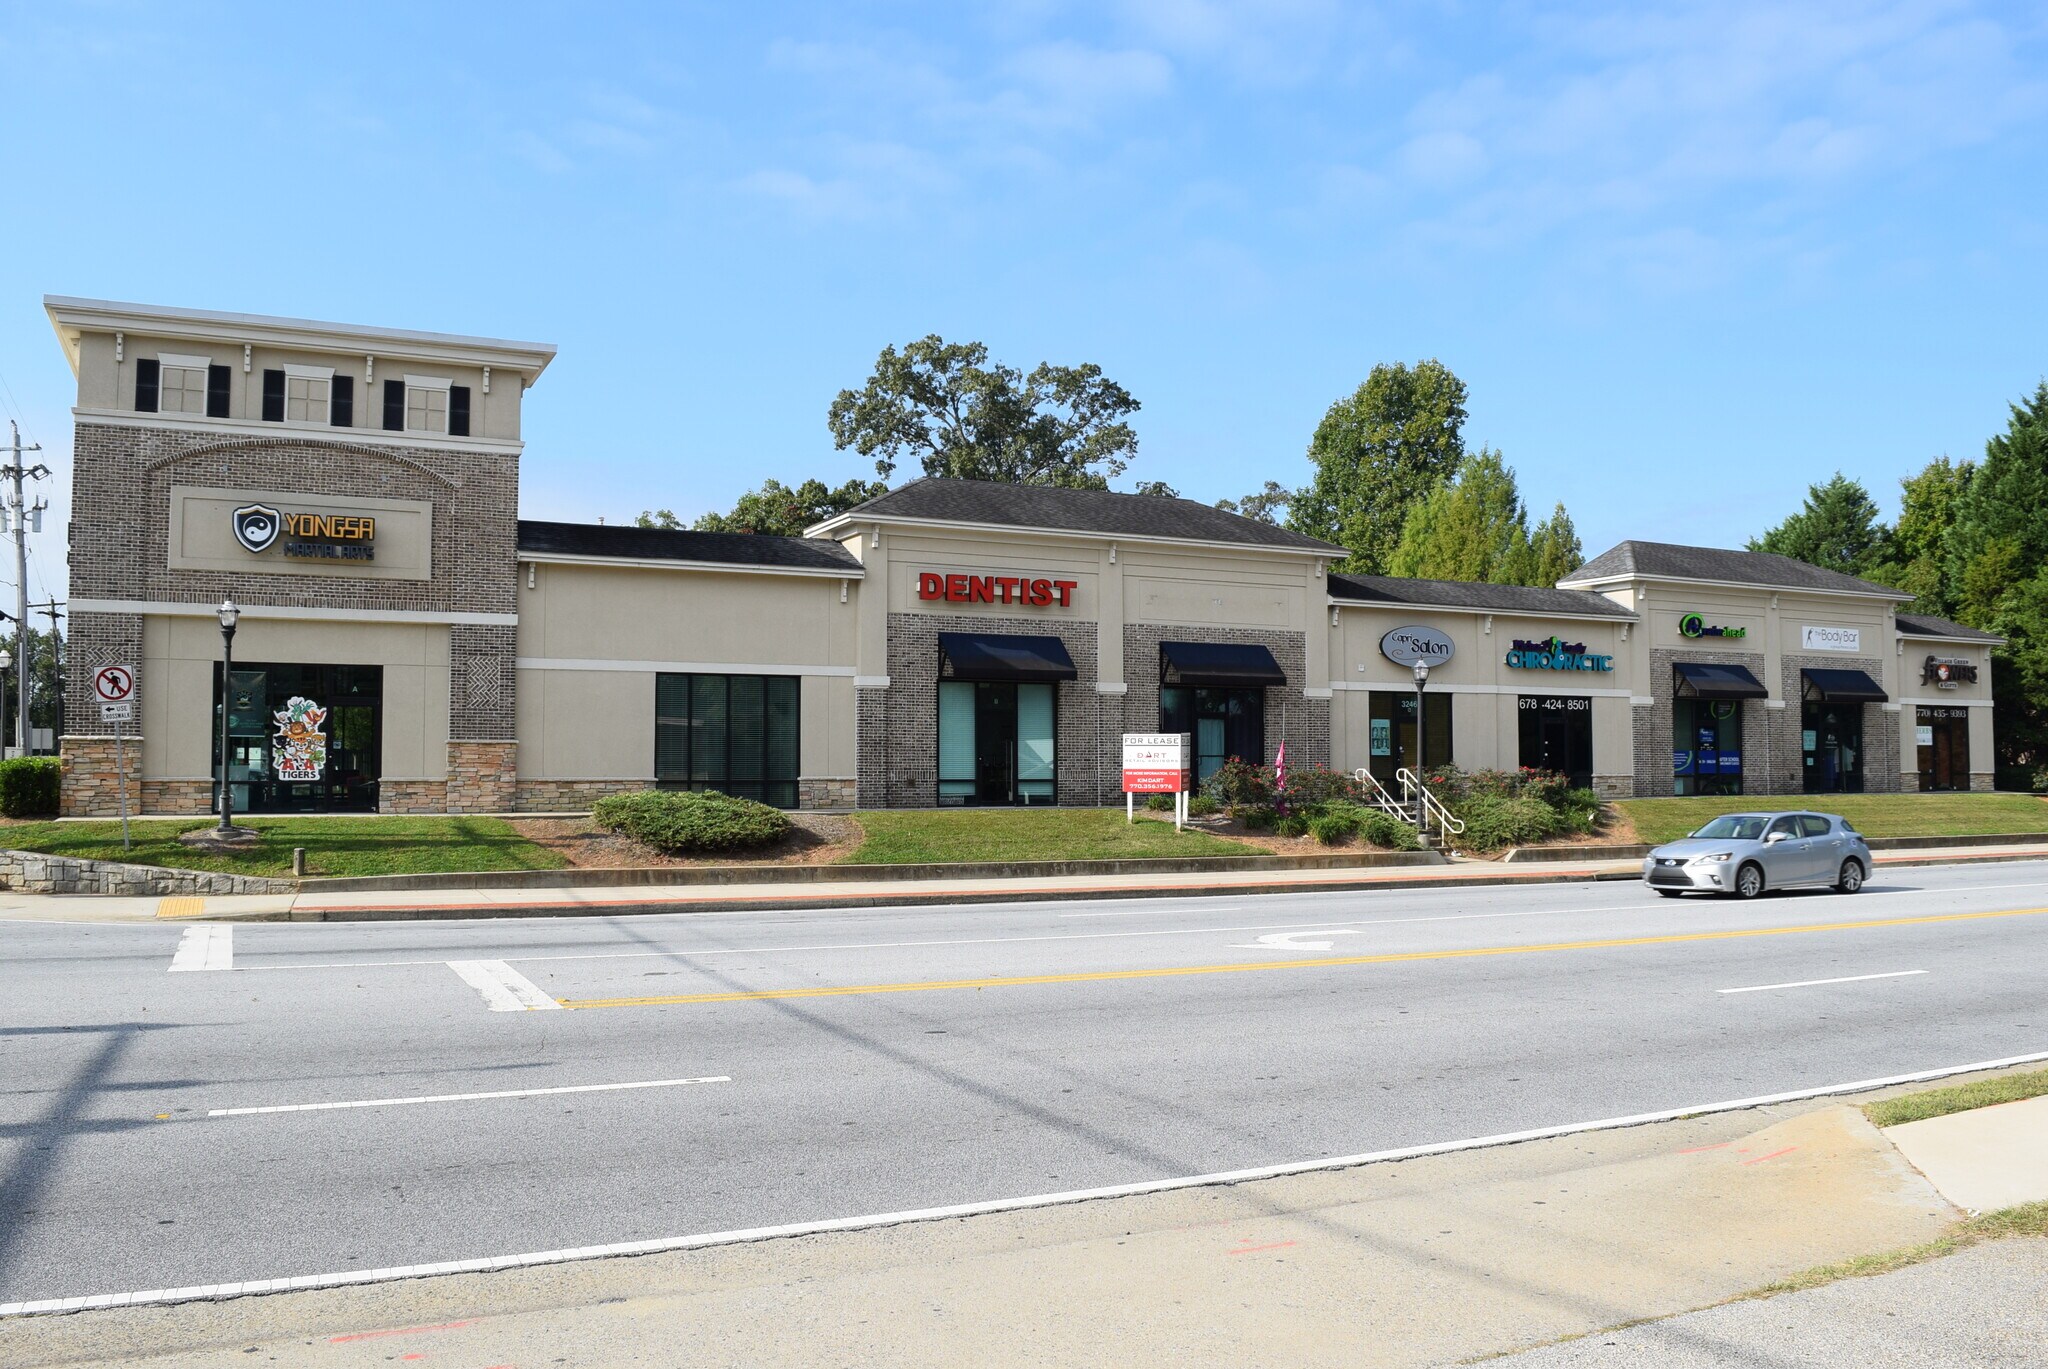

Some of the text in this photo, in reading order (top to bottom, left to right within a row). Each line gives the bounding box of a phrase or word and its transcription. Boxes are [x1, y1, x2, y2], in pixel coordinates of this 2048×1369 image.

[284, 513, 375, 540] YONGSA
[284, 542, 375, 560] MARTIAL ARTS
[919, 573, 1077, 607] DENTIST
[1392, 632, 1413, 644] Capri
[1411, 638, 1449, 655] Salon
[1401, 700, 1418, 708] 3246
[1519, 698, 1537, 709] 678
[1567, 700, 1589, 710] 8501
[282, 758, 316, 771] AA
[281, 771, 317, 779] TIGERS
